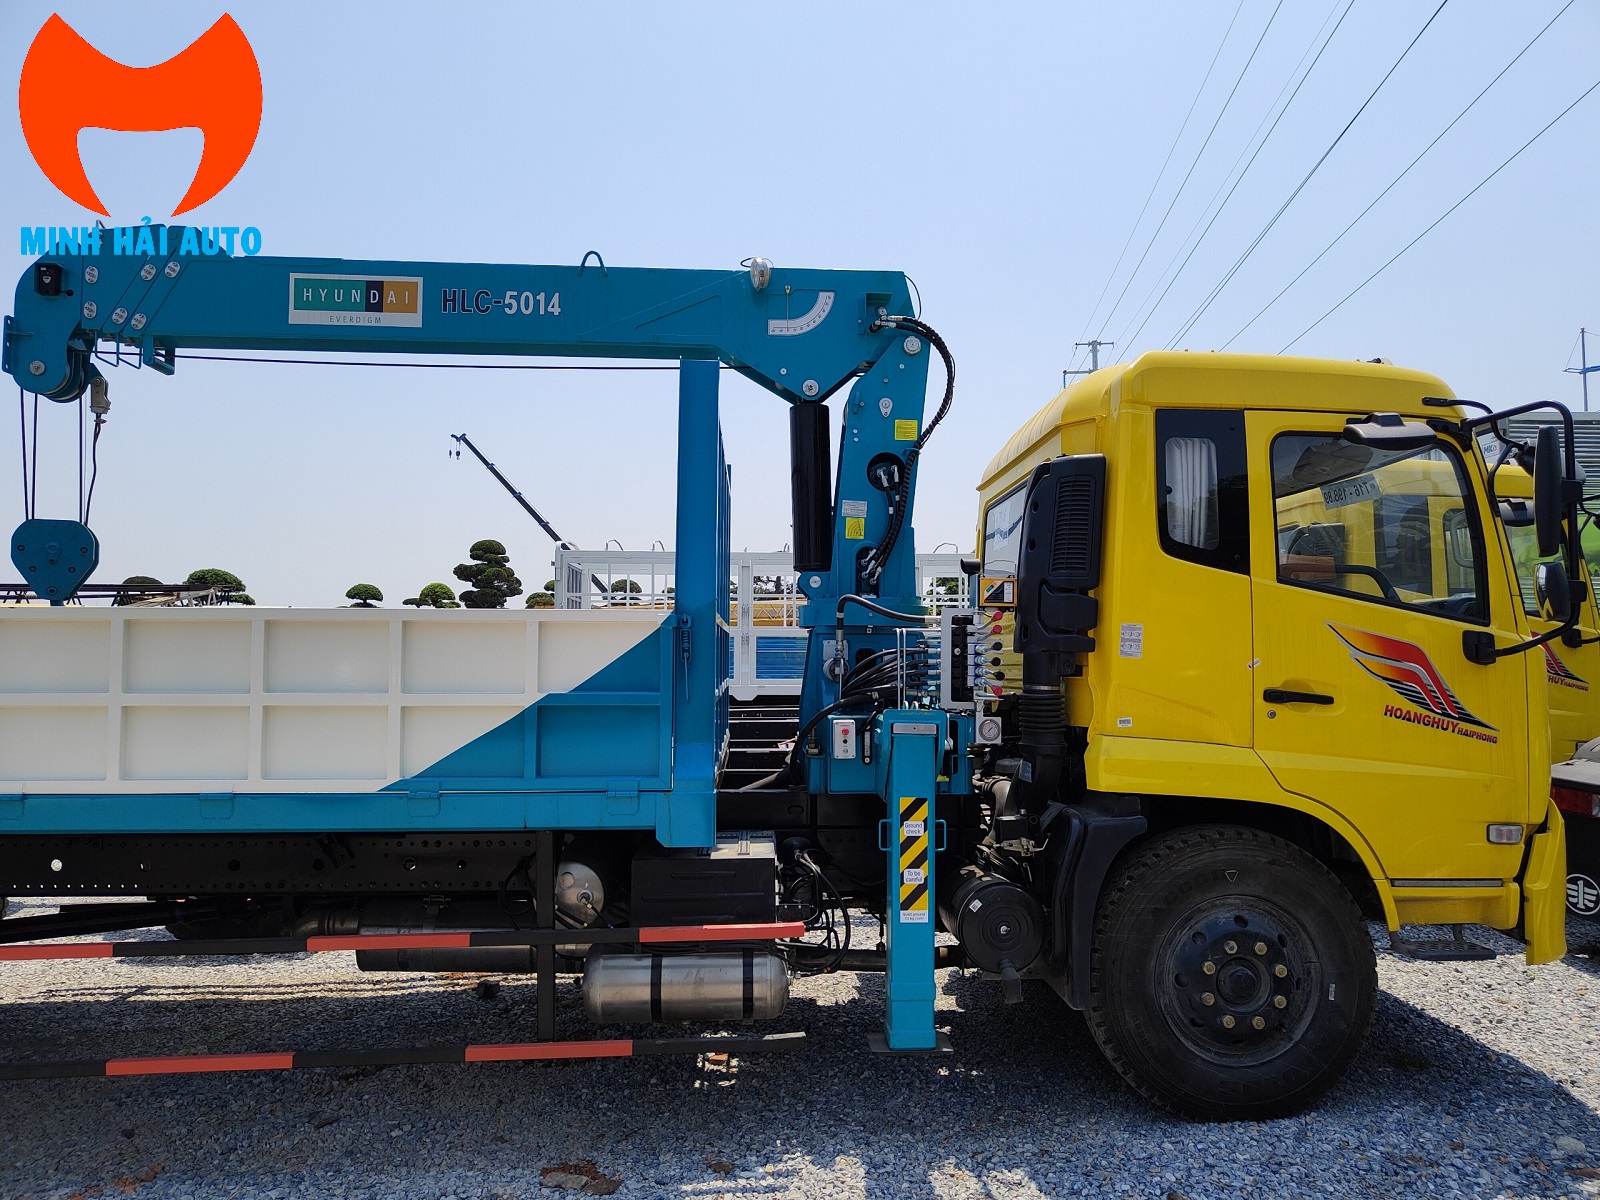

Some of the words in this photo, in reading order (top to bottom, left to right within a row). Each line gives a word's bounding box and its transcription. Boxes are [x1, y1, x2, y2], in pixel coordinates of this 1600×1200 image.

[302, 287, 410, 305] HYUNDAI
[441, 288, 562, 316] HLC-5014
[329, 315, 382, 325] EVERDIGM
[1383, 704, 1460, 734] HOANGHUY
[1457, 726, 1498, 745] HAIPHONG
